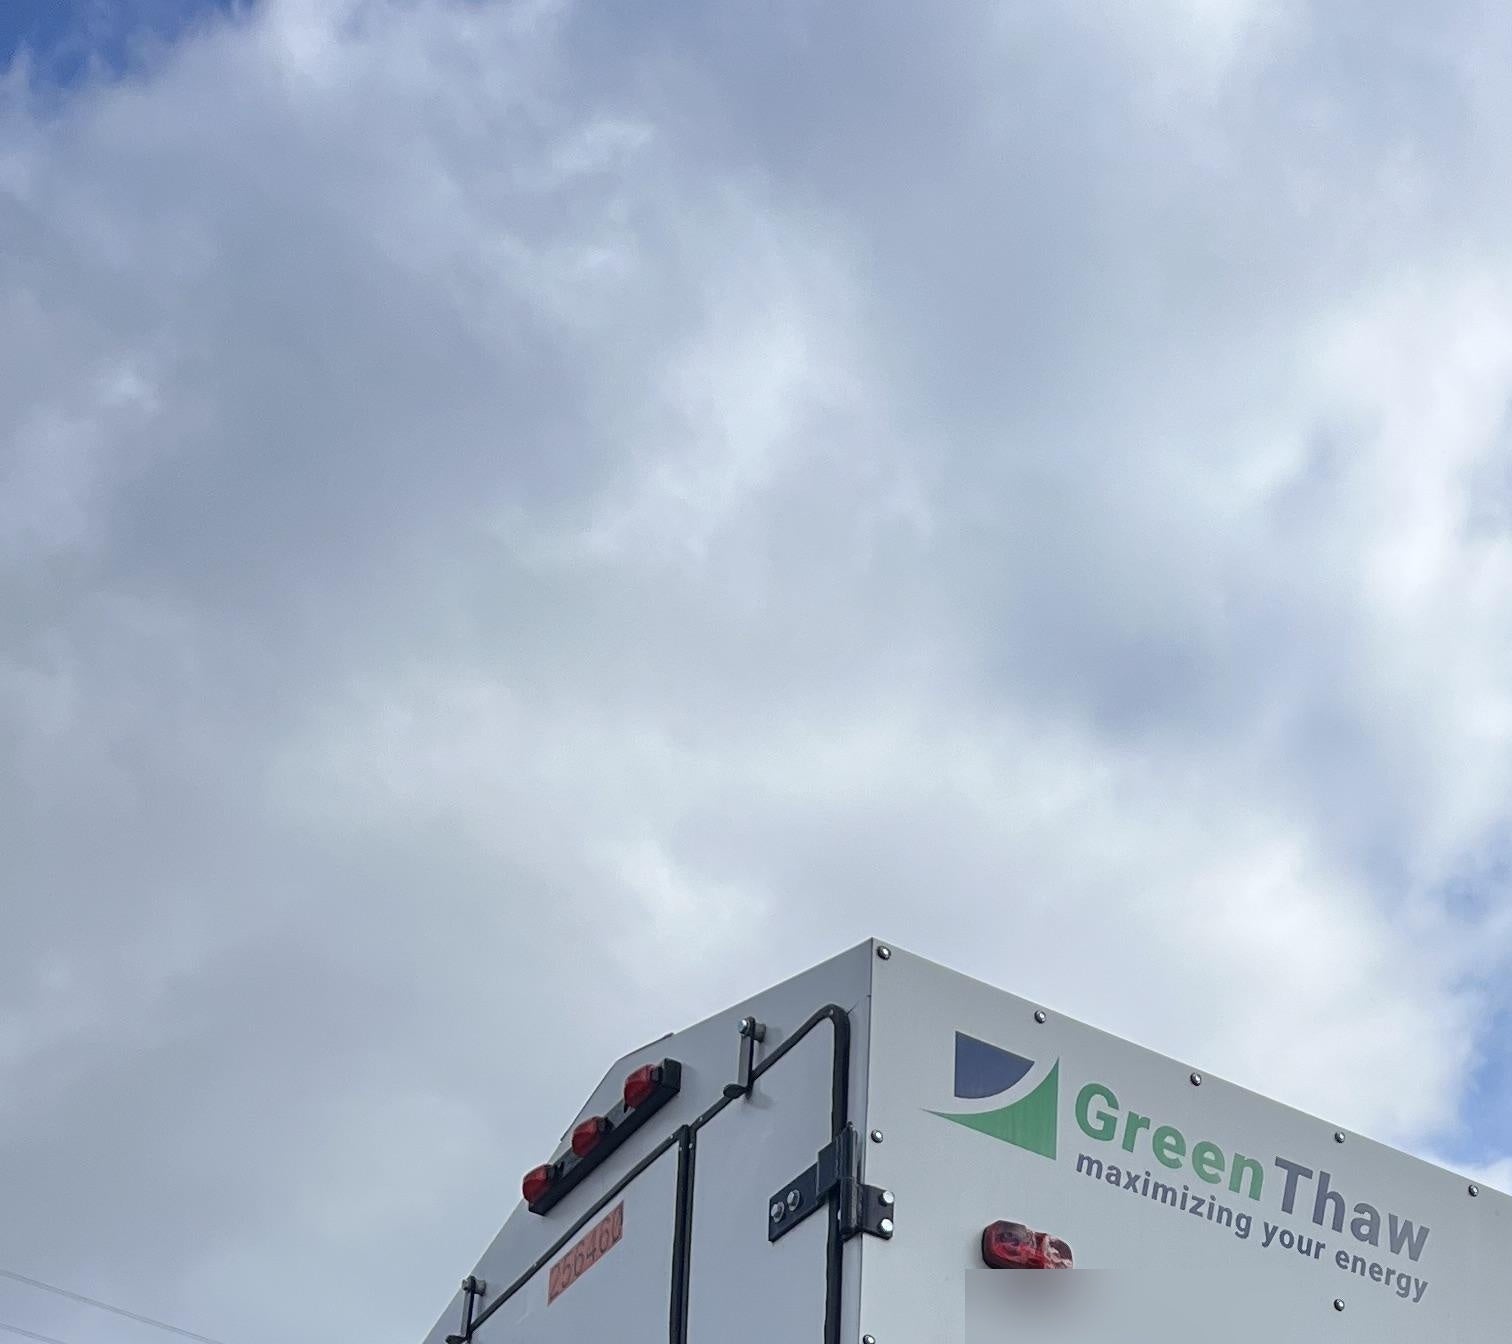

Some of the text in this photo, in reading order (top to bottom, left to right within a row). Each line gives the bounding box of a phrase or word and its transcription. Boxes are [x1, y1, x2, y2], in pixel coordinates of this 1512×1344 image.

[1075, 1152, 1429, 1303] maximizing your energy
